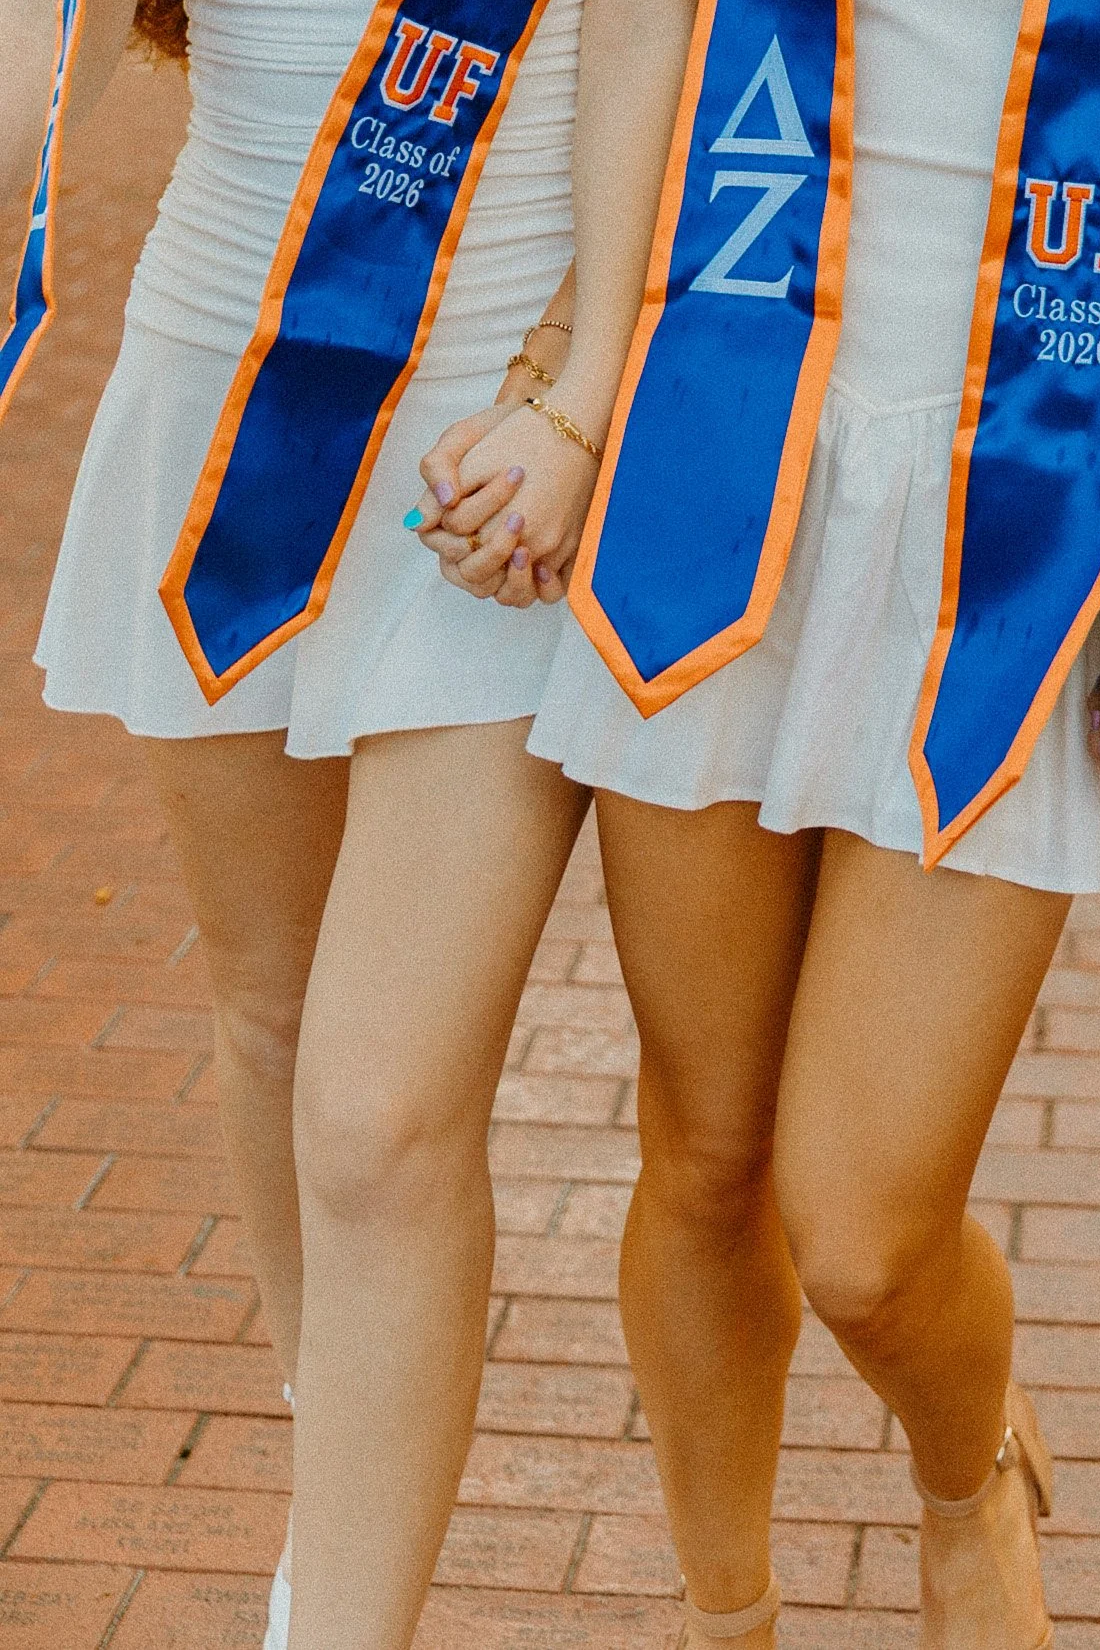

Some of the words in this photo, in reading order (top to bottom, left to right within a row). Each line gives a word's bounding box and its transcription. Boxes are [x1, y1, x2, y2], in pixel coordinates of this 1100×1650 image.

[380, 17, 501, 126] UF
[351, 116, 428, 169] Class
[429, 146, 461, 177] of
[358, 162, 425, 208] 2026
